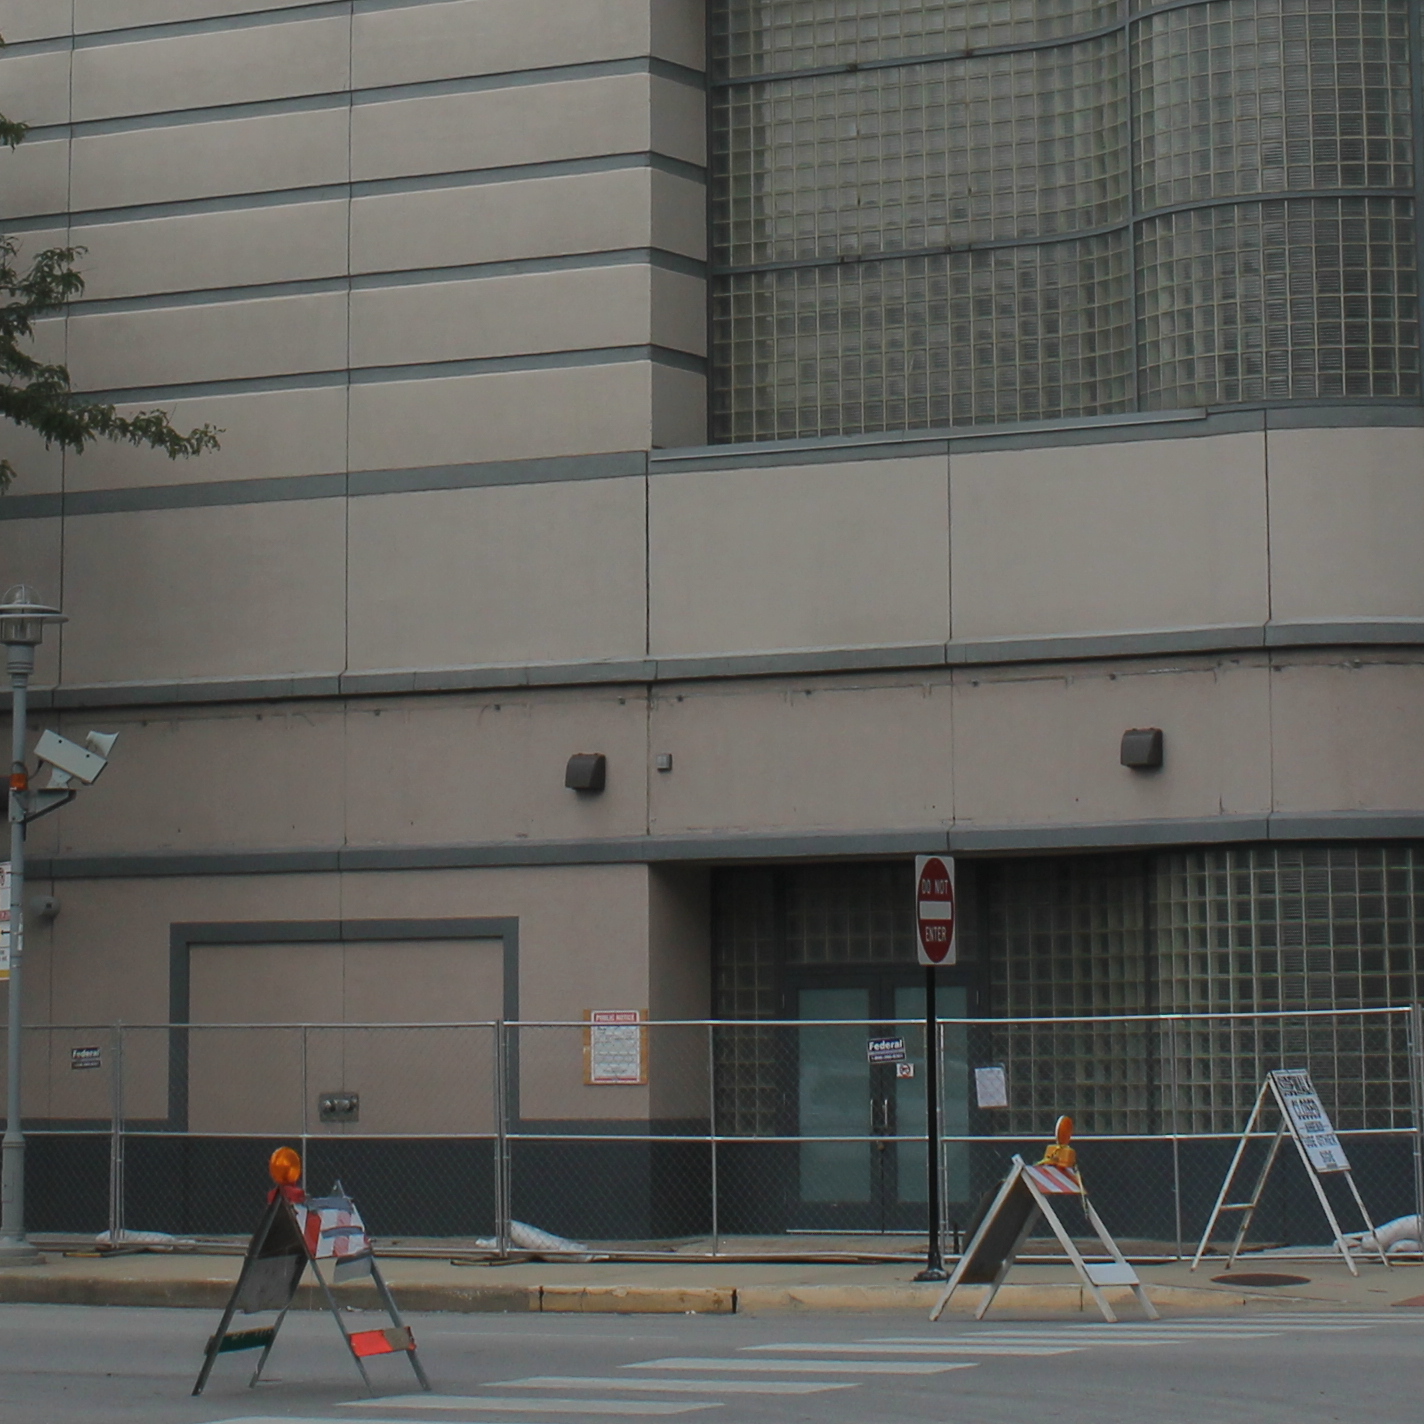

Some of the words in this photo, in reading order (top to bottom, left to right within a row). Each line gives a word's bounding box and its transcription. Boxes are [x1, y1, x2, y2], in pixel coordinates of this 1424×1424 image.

[921, 878, 932, 894] DO
[934, 879, 949, 895] NOT
[924, 926, 948, 942] ENTER
[868, 1039, 903, 1051] Federal
